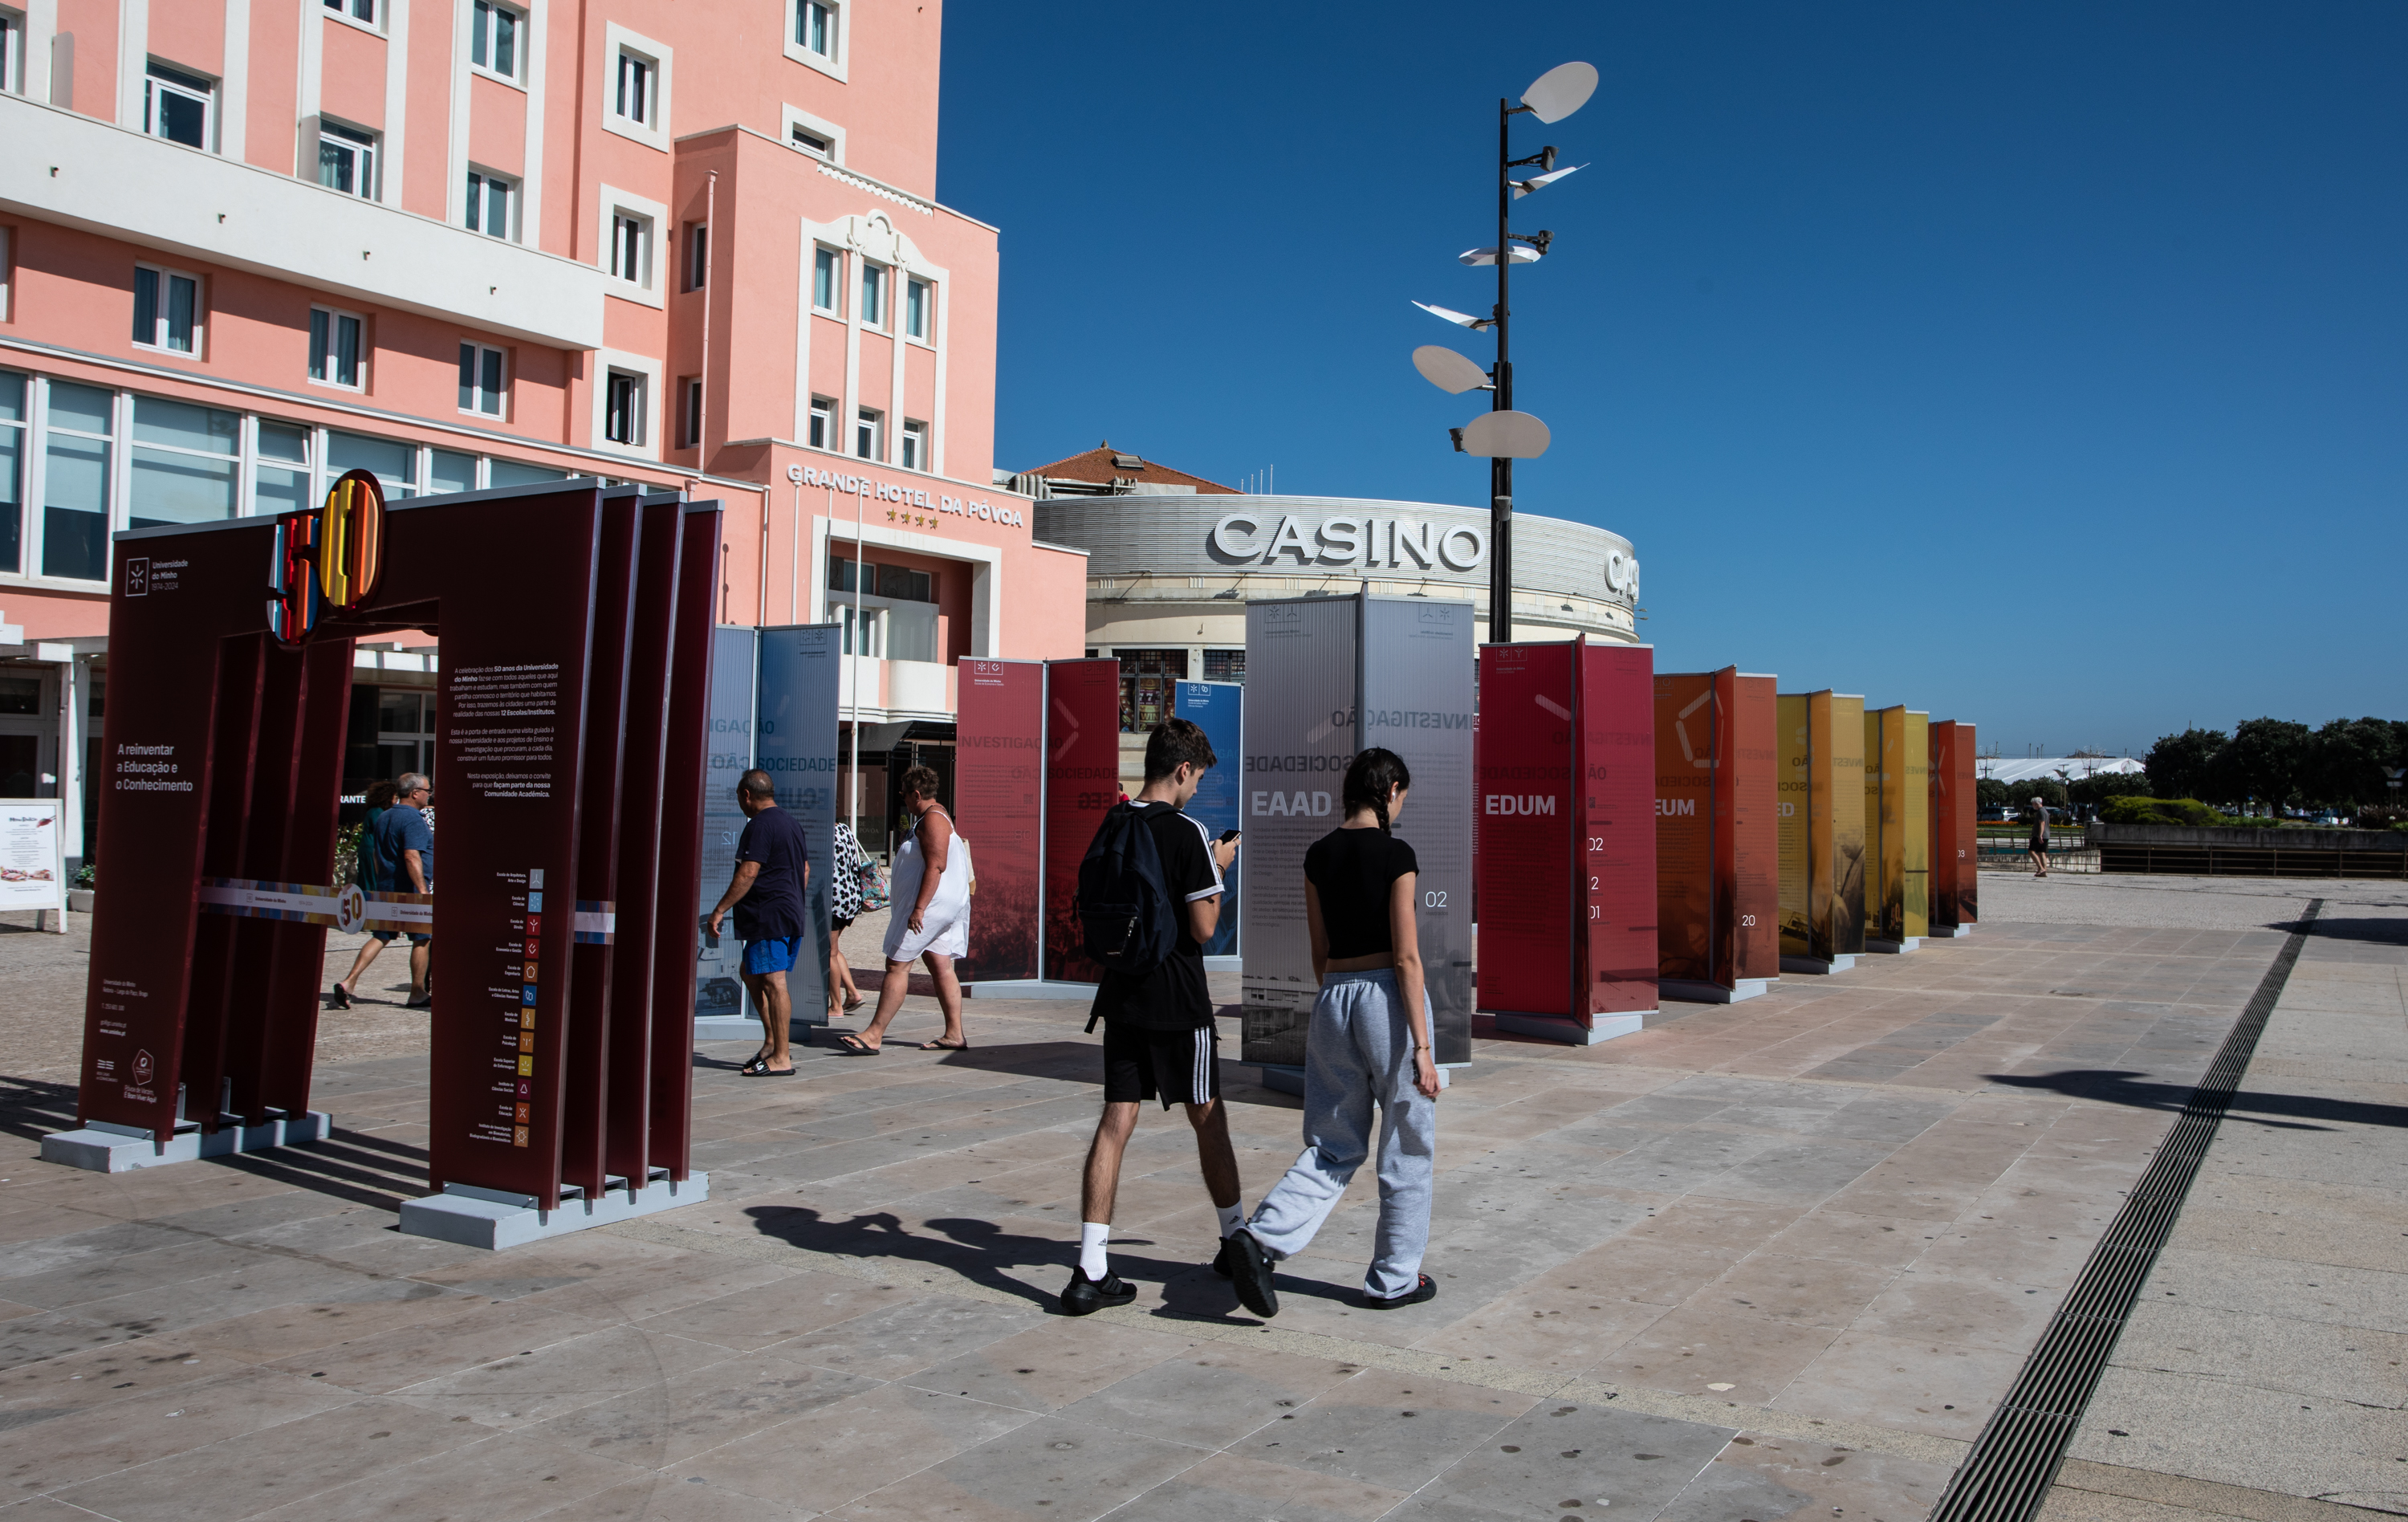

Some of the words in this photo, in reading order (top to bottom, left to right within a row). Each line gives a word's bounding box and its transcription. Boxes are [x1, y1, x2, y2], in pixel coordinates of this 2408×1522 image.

[787, 464, 871, 496] GRANDE
[875, 482, 936, 510] HOTEL
[939, 495, 963, 515] DA
[967, 499, 1023, 527] PÓVOA
[1213, 513, 1487, 568] CASINO
[153, 560, 189, 569] Universidade
[266, 479, 379, 645] 50
[161, 572, 177, 580] Minho
[1605, 550, 1639, 605] CAS
[151, 582, 178, 591] 1974-2024
[510, 682, 530, 690] também
[536, 700, 550, 708] parte
[534, 726, 551, 735] guiada
[117, 743, 124, 755] A
[126, 743, 174, 755] reinventar
[116, 763, 123, 772] a
[124, 761, 169, 776] Educação
[171, 764, 178, 773] e
[757, 757, 836, 771] SOCIEDADE
[116, 780, 122, 790] o
[124, 779, 193, 792] Conhecimento
[340, 796, 366, 804] RANTE
[1252, 791, 1332, 816] EAAD
[1485, 795, 1556, 816] EDUM
[1655, 799, 1694, 816] EUM
[1591, 877, 1599, 889] 2
[1426, 891, 1447, 908] 02
[1742, 914, 1755, 926] 20
